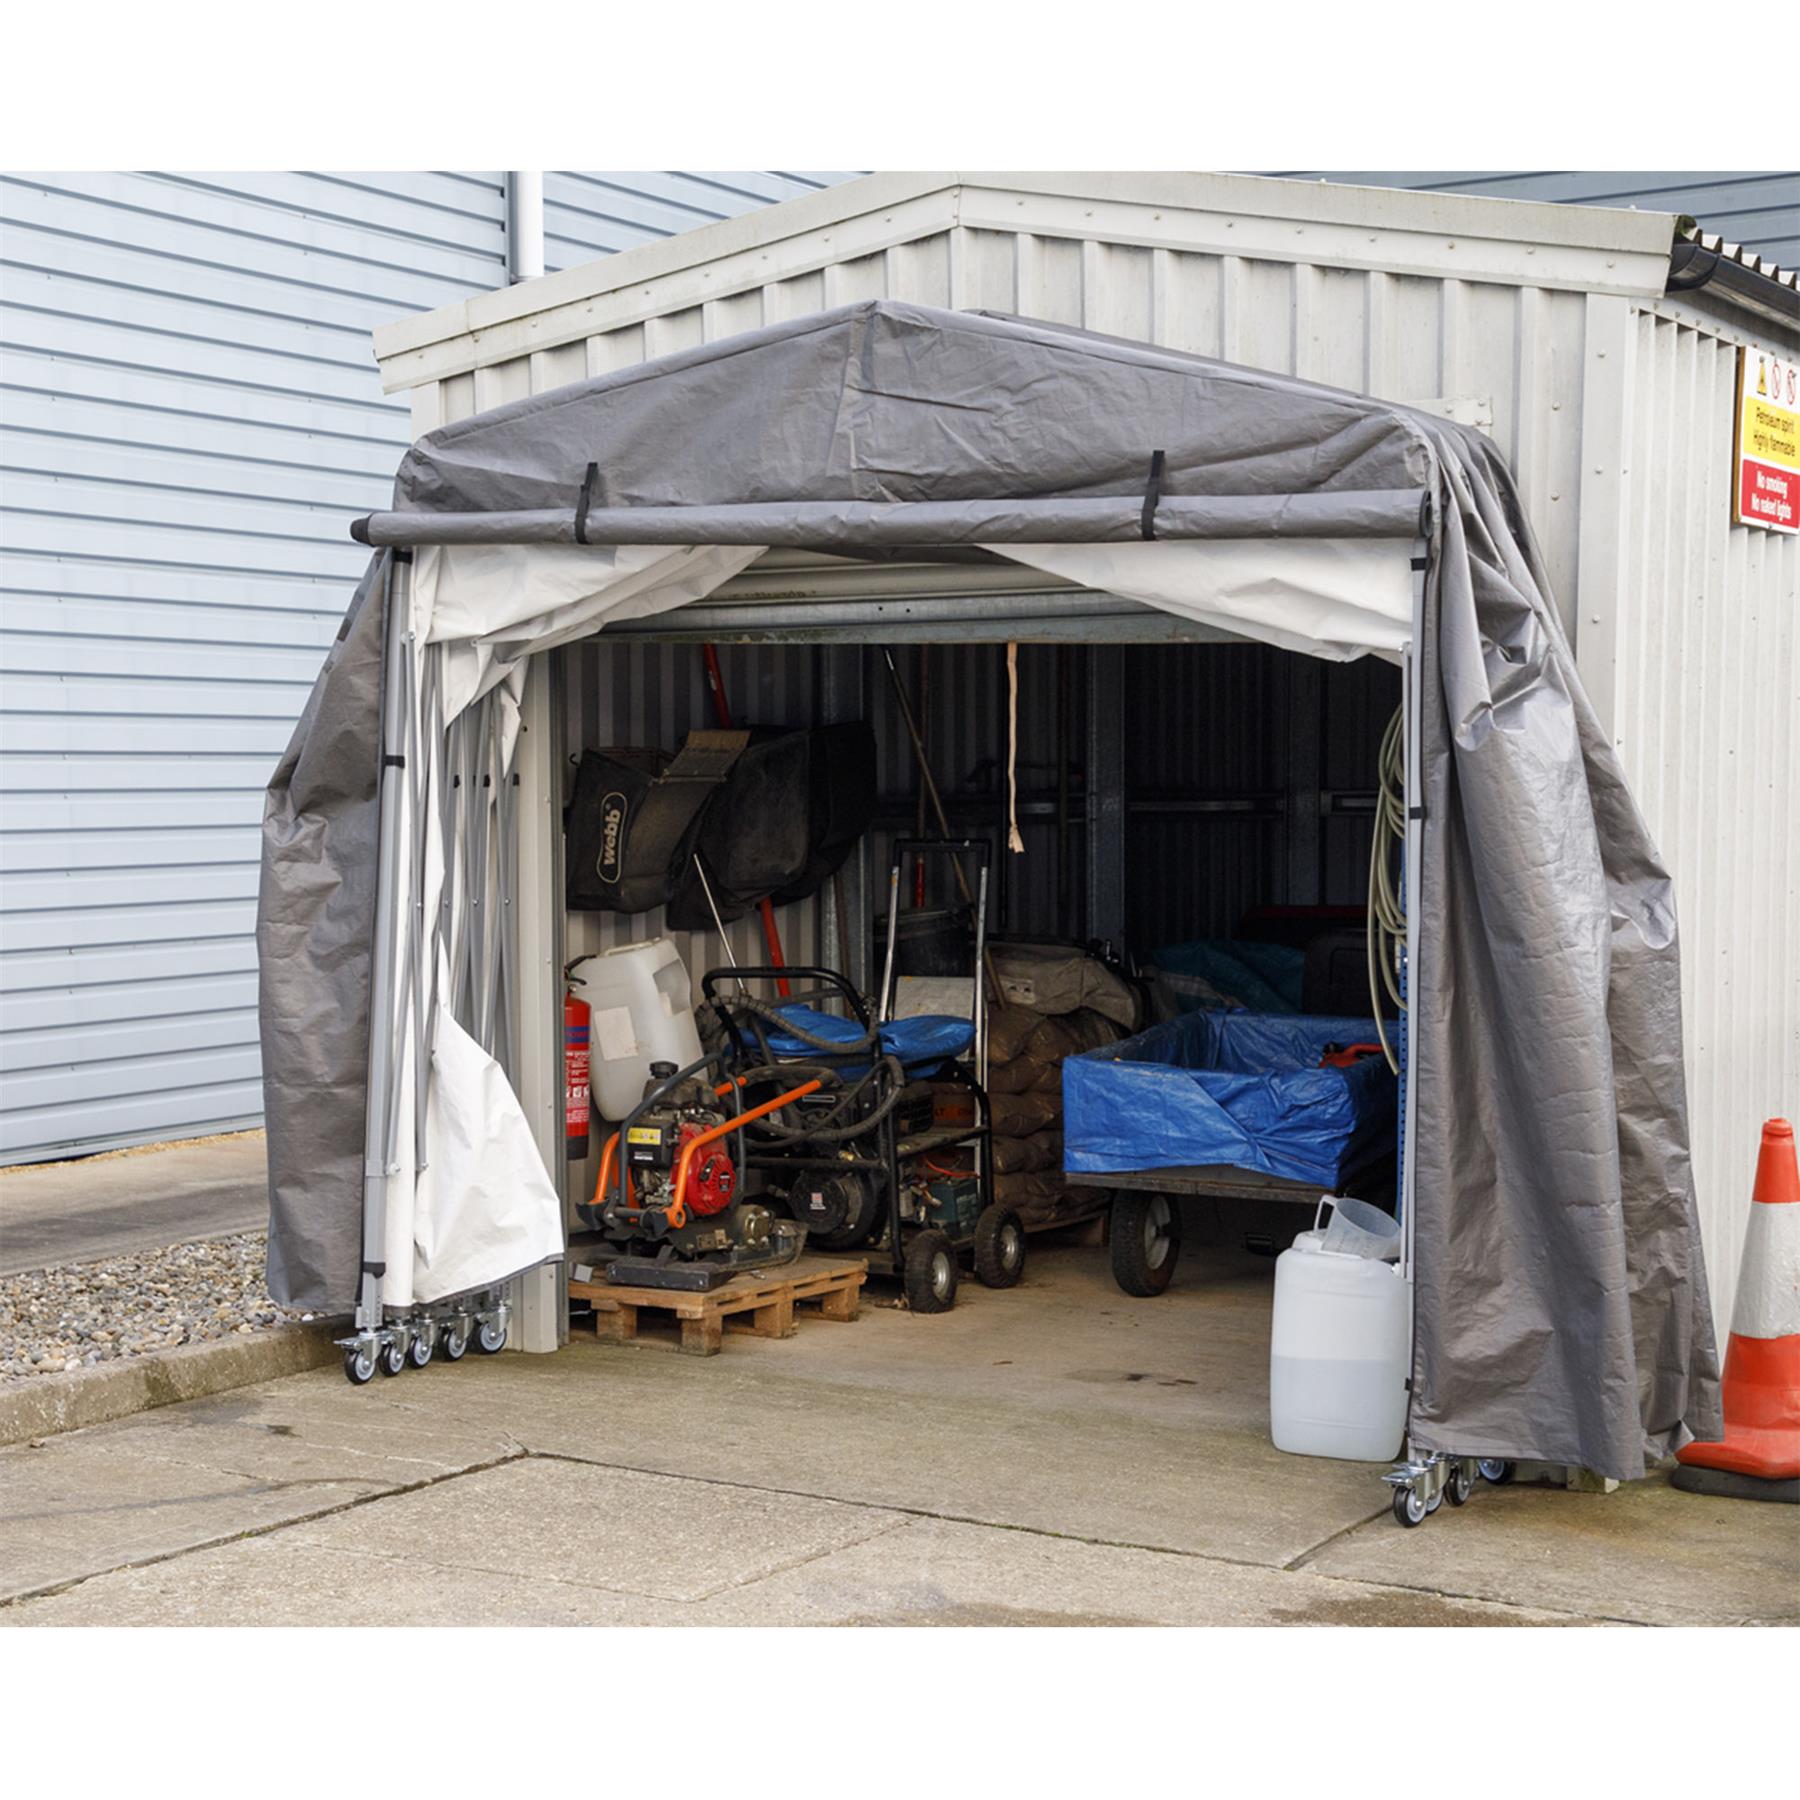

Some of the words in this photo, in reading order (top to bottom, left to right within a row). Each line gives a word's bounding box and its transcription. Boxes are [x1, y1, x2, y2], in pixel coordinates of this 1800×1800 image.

[1753, 430, 1768, 453] Highly
[1756, 470, 1765, 489] No
[1765, 475, 1788, 499] smoking
[1751, 492, 1760, 512] No
[1760, 495, 1776, 515] naked
[1776, 498, 1792, 522] lights
